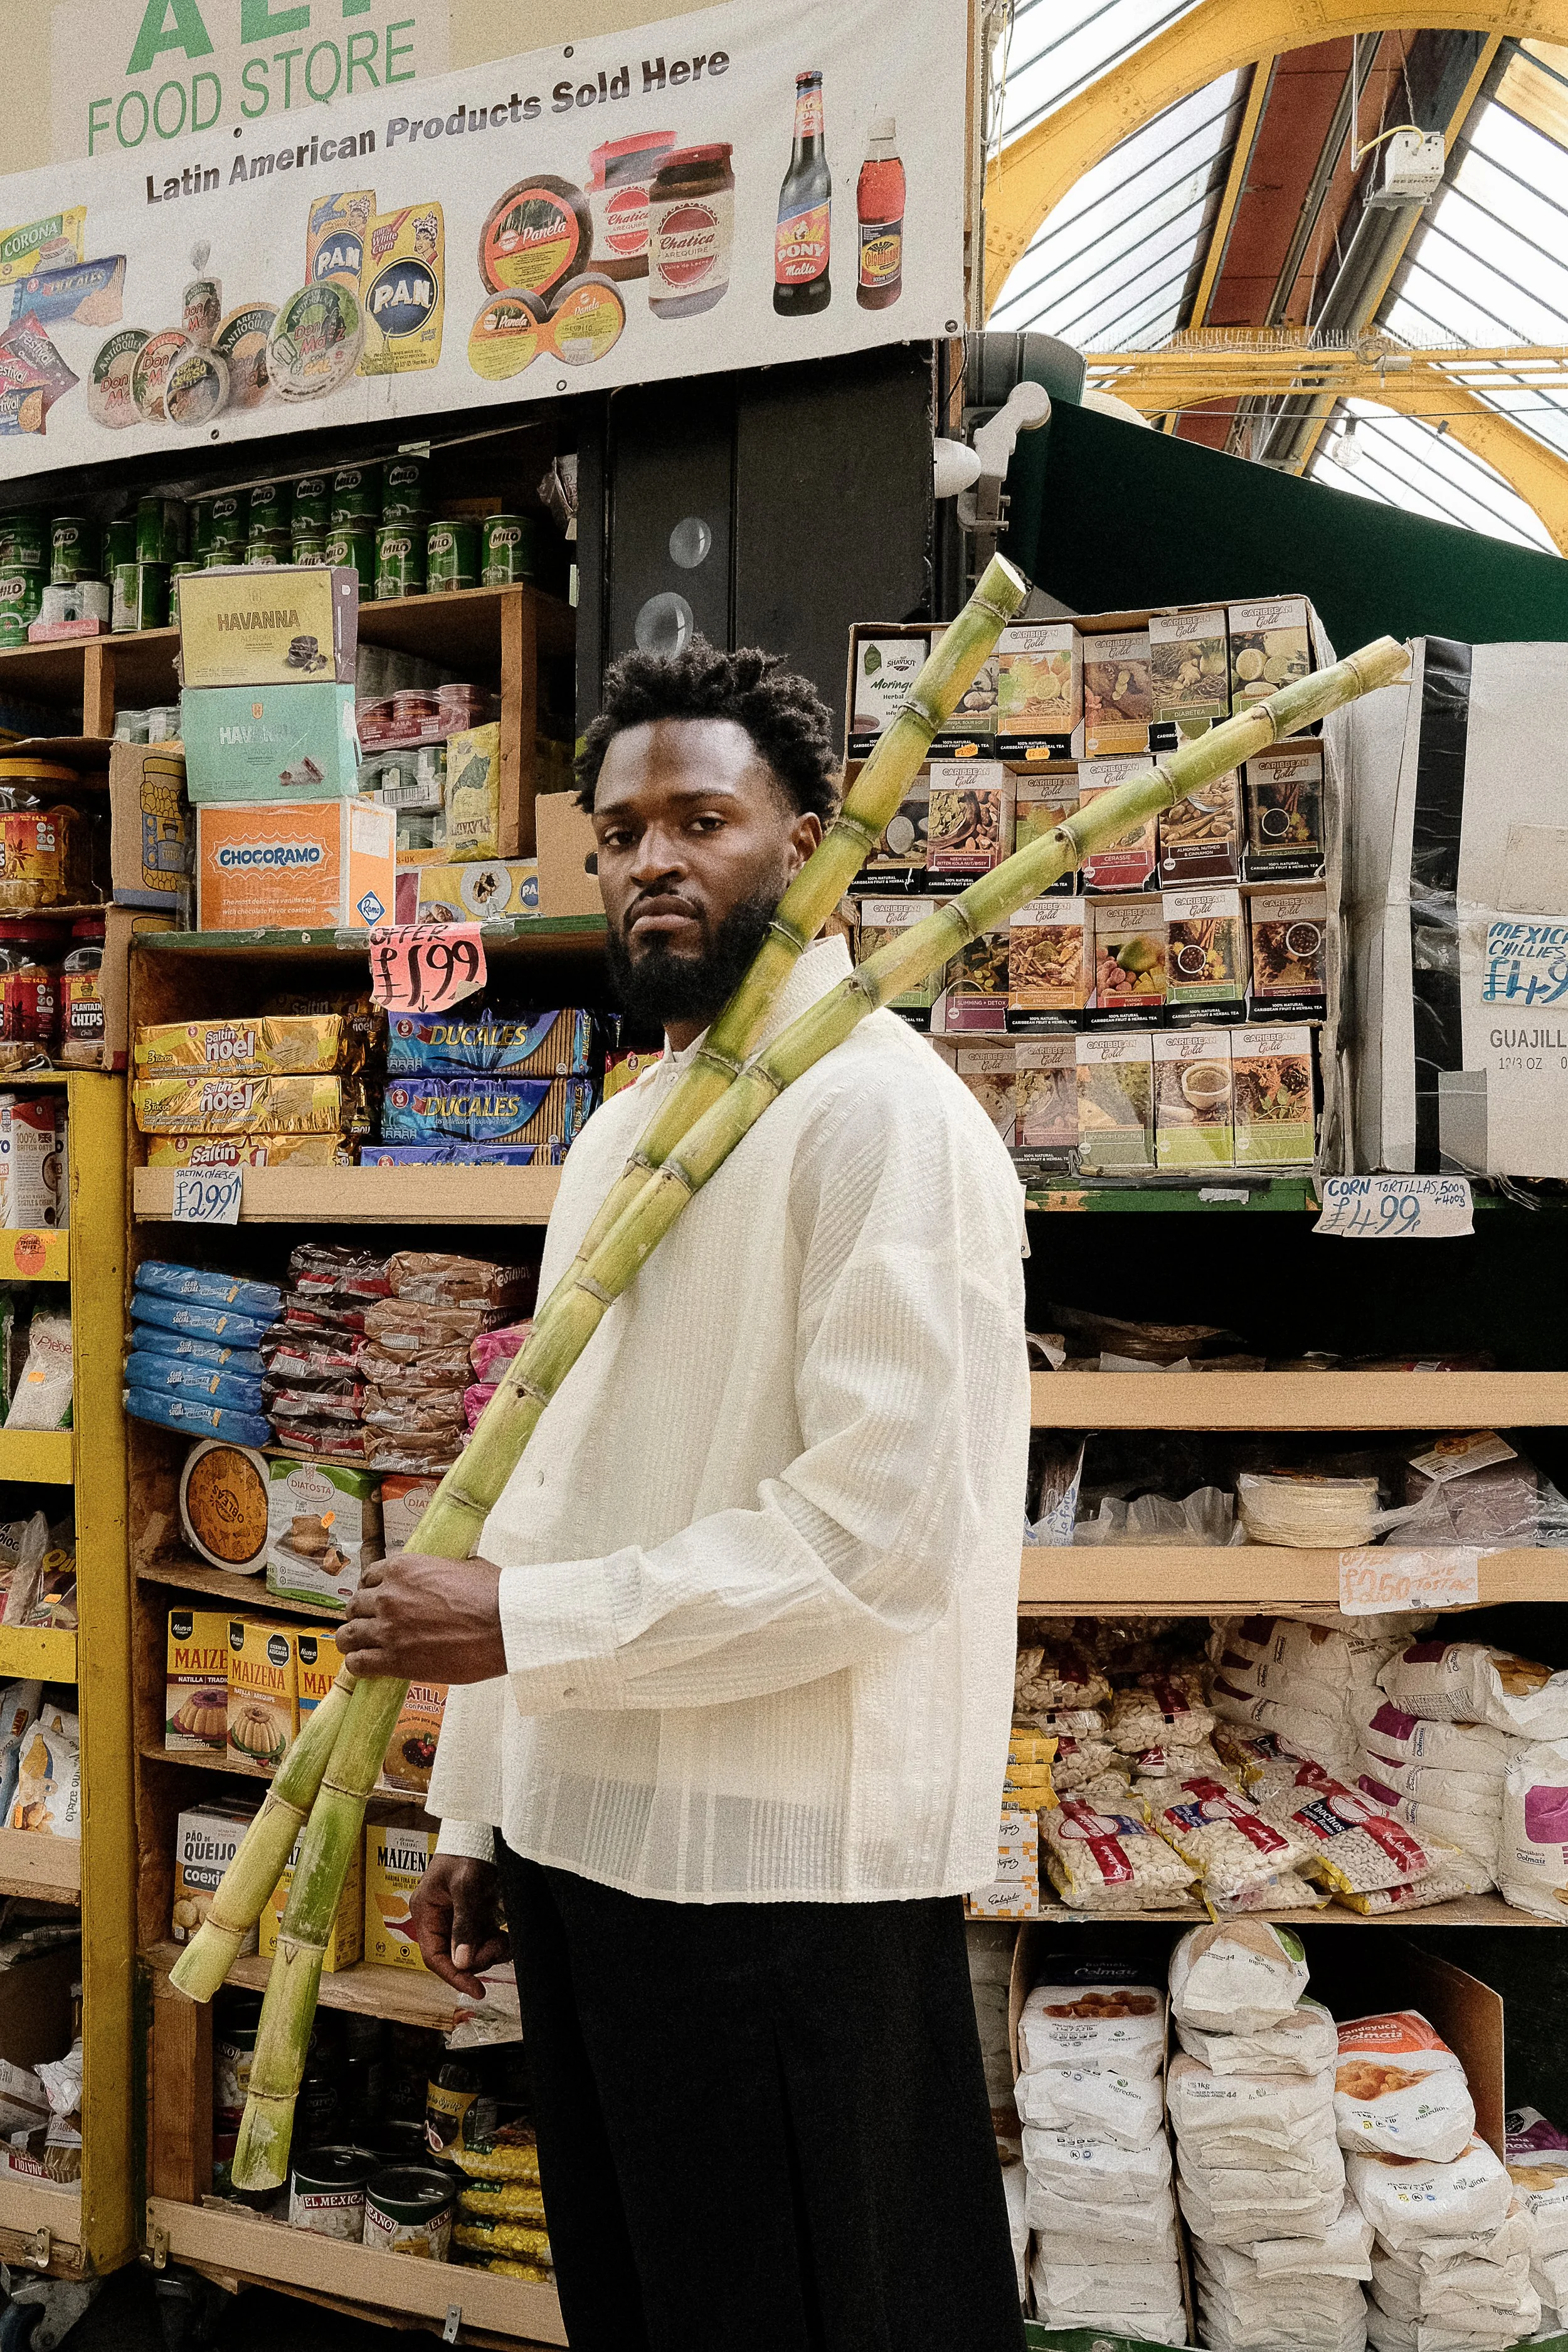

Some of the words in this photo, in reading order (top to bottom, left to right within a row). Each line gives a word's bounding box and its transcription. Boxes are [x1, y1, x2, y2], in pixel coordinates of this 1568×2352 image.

[88, 72, 222, 156] FOOD
[240, 19, 415, 119] STORE
[146, 166, 220, 205] Latin
[228, 128, 376, 186] American
[385, 92, 541, 148] Products
[551, 71, 630, 114] Sold
[641, 49, 731, 92] Here
[373, 231, 397, 246] White
[522, 220, 566, 245] Panela
[4, 221, 58, 258] CORONA
[660, 233, 715, 250] Chatica
[373, 241, 394, 254] Corn
[664, 247, 709, 258] AREQUIPE
[777, 243, 825, 263] PONY
[785, 262, 817, 276] Malta
[573, 299, 600, 317] Panela
[498, 315, 527, 329] Panela
[294, 321, 321, 340] Don
[111, 333, 135, 345] AREPA
[19, 329, 54, 366] Festival
[143, 355, 168, 370] Don
[100, 374, 129, 393] Don
[334, 475, 360, 489] MILO
[390, 469, 418, 482] MILO
[297, 483, 324, 496] MILO
[53, 531, 77, 544] MILO
[428, 537, 451, 550] MILO
[490, 532, 519, 544] MILO
[381, 542, 410, 554] MILO
[1241, 606, 1291, 617] CARIBBEAN
[218, 610, 300, 631] HAVANNA
[1161, 615, 1210, 627] CARIBBEAN
[1256, 614, 1279, 628] Gold
[1010, 629, 1059, 638] CARIBBEAN
[1175, 624, 1198, 638] Gold
[1024, 637, 1045, 650] Gold
[1095, 638, 1143, 649] CARIBBEAN
[1109, 646, 1130, 659] Gold
[887, 659, 916, 667] SHAVUOT
[1174, 709, 1205, 718] DIABETEA
[942, 766, 990, 776] CARIBBEAN
[1090, 763, 1140, 774] CARIBBEAN
[1258, 759, 1308, 770] CARIBBEAN
[1104, 771, 1126, 784] Gold
[1273, 767, 1296, 781] Gold
[955, 775, 977, 787] Gold
[1027, 778, 1076, 787] CARIBBEAN
[1041, 785, 1062, 798] Gold
[220, 847, 320, 866] CHOCORAMO
[363, 899, 380, 915] Ramo
[1174, 895, 1225, 906] CARIBBEAN
[1263, 897, 1313, 908] CARIBBEAN
[873, 904, 921, 913] CARIBBEAN
[1106, 908, 1155, 918] CARIBBEAN
[1189, 904, 1212, 918] Gold
[1278, 905, 1300, 919] Gold
[886, 912, 907, 924] Gold
[1036, 909, 1057, 923] Gold
[1121, 915, 1142, 928] Gold
[369, 924, 450, 945] OFFER
[1489, 940, 1566, 959] CHILLIES
[72, 1004, 102, 1012] PLANTAIN
[72, 1013, 103, 1026] CHIPS
[429, 1025, 528, 1045] DUCALES
[1166, 1036, 1217, 1047] CARIBBEAN
[1243, 1032, 1295, 1044] CARIBBEAN
[206, 1031, 255, 1061] noel
[1027, 1046, 1074, 1056] CARIBBEAN
[1087, 1039, 1138, 1050] CARIBBEAN
[1180, 1044, 1204, 1057] Gold
[1258, 1041, 1281, 1054] Gold
[147, 1051, 156, 1064] 3
[155, 1054, 173, 1062] Tacos
[1101, 1046, 1124, 1061] Gold
[982, 1059, 1002, 1071] Gold
[1041, 1054, 1062, 1067] Gold
[1527, 1057, 1542, 1069] OZ
[200, 1084, 254, 1112] noel
[152, 1103, 171, 1111] Tacos
[424, 1096, 521, 1117] DUCALES
[16, 1133, 36, 1143] 100%
[204, 1168, 236, 1179] CHEESE
[1328, 1179, 1371, 1196] CORN
[1441, 1181, 1465, 1197] 500g
[291, 1480, 331, 1495] DIATOSTA
[212, 1485, 244, 1523] OBLEAS
[300, 1647, 317, 1657] Nueva
[232, 1659, 285, 1690] MAIZENA
[235, 1688, 251, 1696] NATILLA
[253, 1693, 276, 1702] AREQUIPE
[418, 1704, 440, 1713] PANELA
[1308, 1802, 1345, 1832] Chochos
[186, 1830, 203, 1841] PÃO
[988, 1894, 1020, 1905] Embajador
[1338, 2023, 1397, 2037] Pandeyuca
[1108, 2083, 1142, 2100] Ingredion
[304, 2196, 319, 2207] EL
